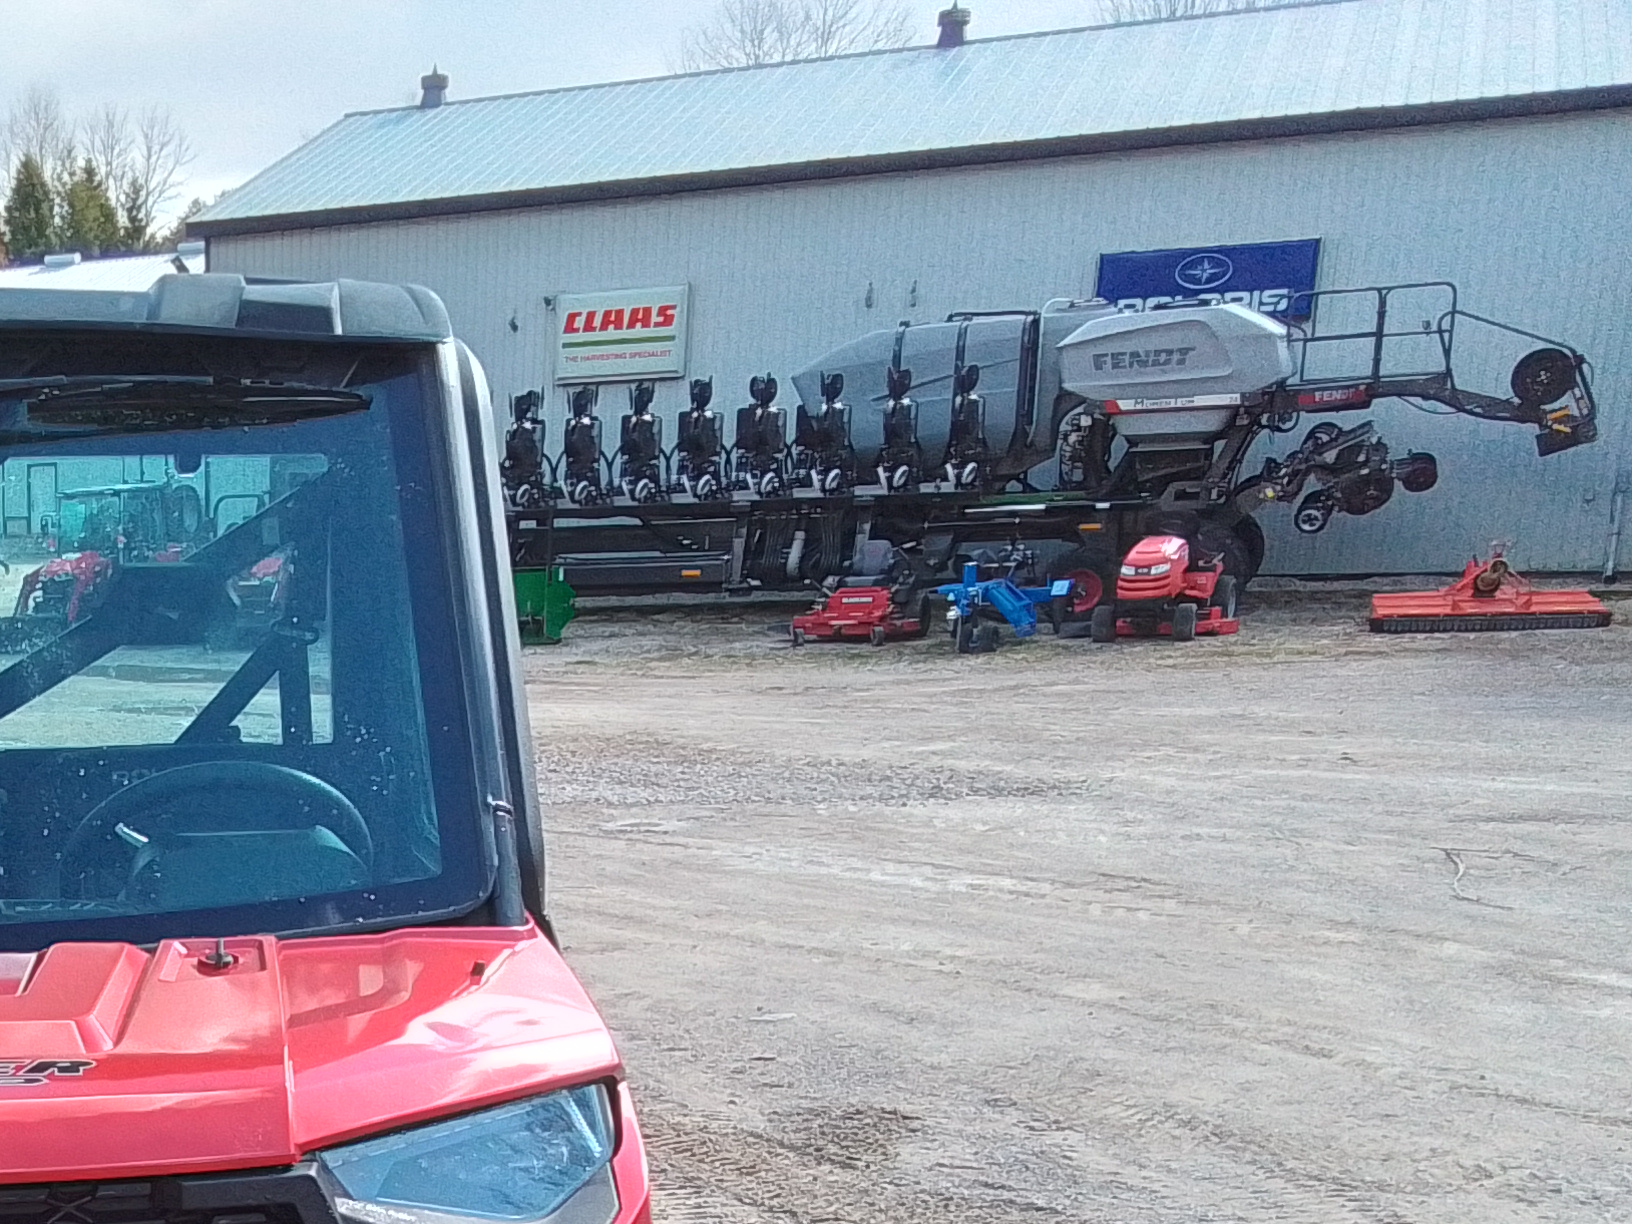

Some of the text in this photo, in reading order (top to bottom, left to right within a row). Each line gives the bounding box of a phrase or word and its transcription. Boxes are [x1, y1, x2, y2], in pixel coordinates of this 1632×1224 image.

[563, 304, 677, 334] CLAAS
[1092, 347, 1196, 371] FENDT
[1314, 388, 1355, 402] FENDT
